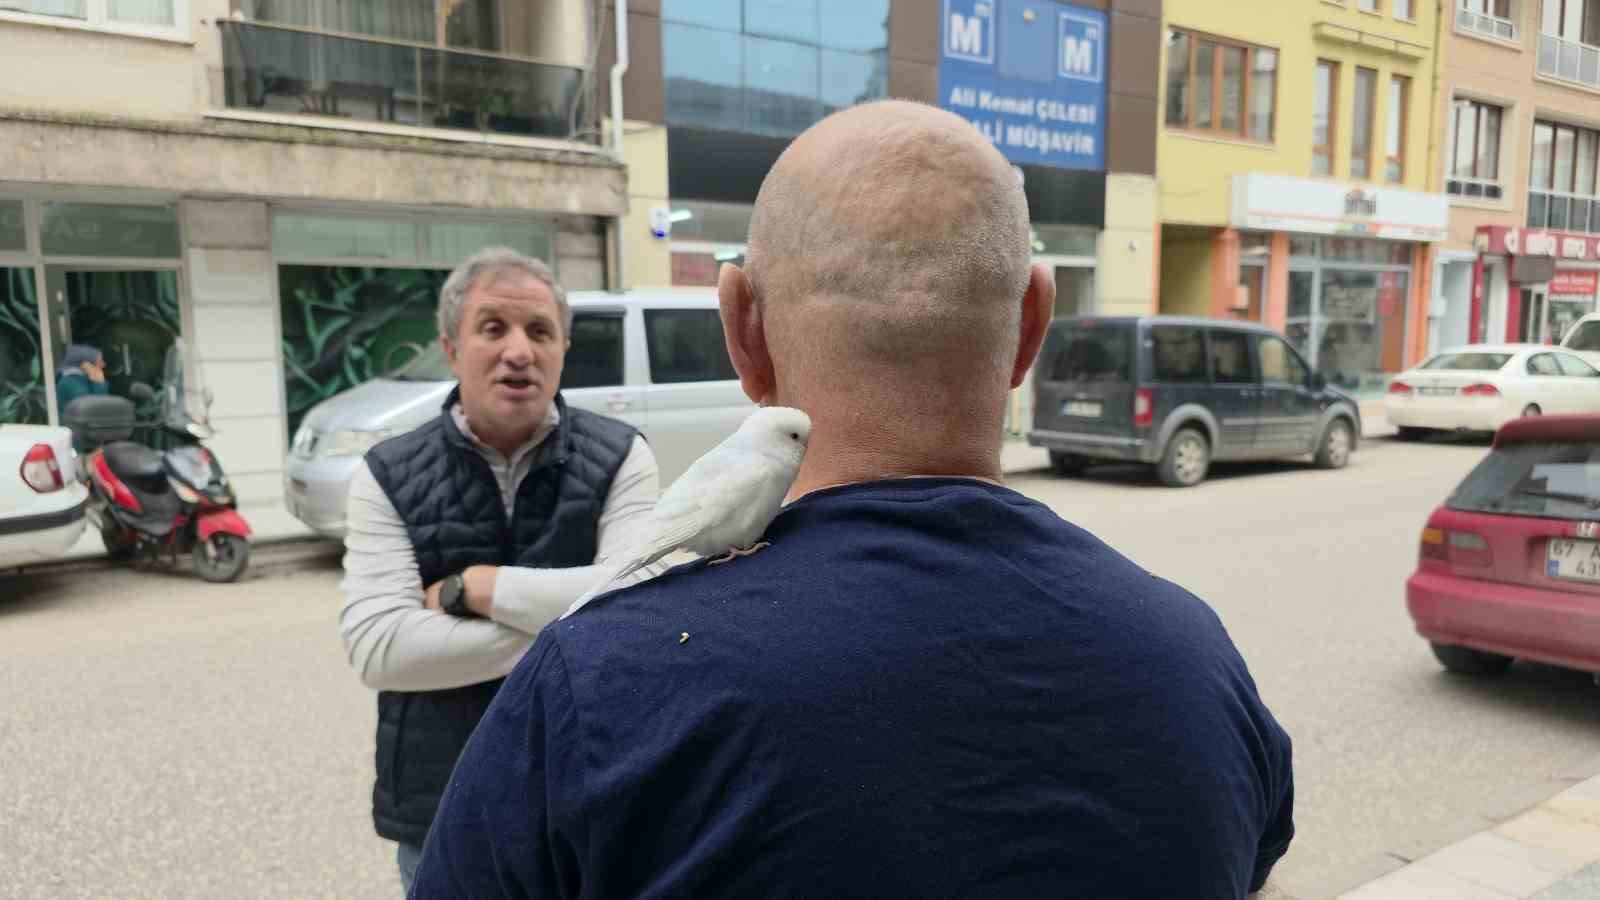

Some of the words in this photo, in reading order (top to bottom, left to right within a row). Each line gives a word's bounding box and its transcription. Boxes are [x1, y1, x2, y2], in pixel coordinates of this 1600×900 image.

[950, 13, 981, 55] M
[1064, 36, 1091, 74] M
[949, 86, 976, 107] Ali
[979, 90, 1034, 116] Kemal
[1006, 123, 1095, 155] MÜŞAVİR
